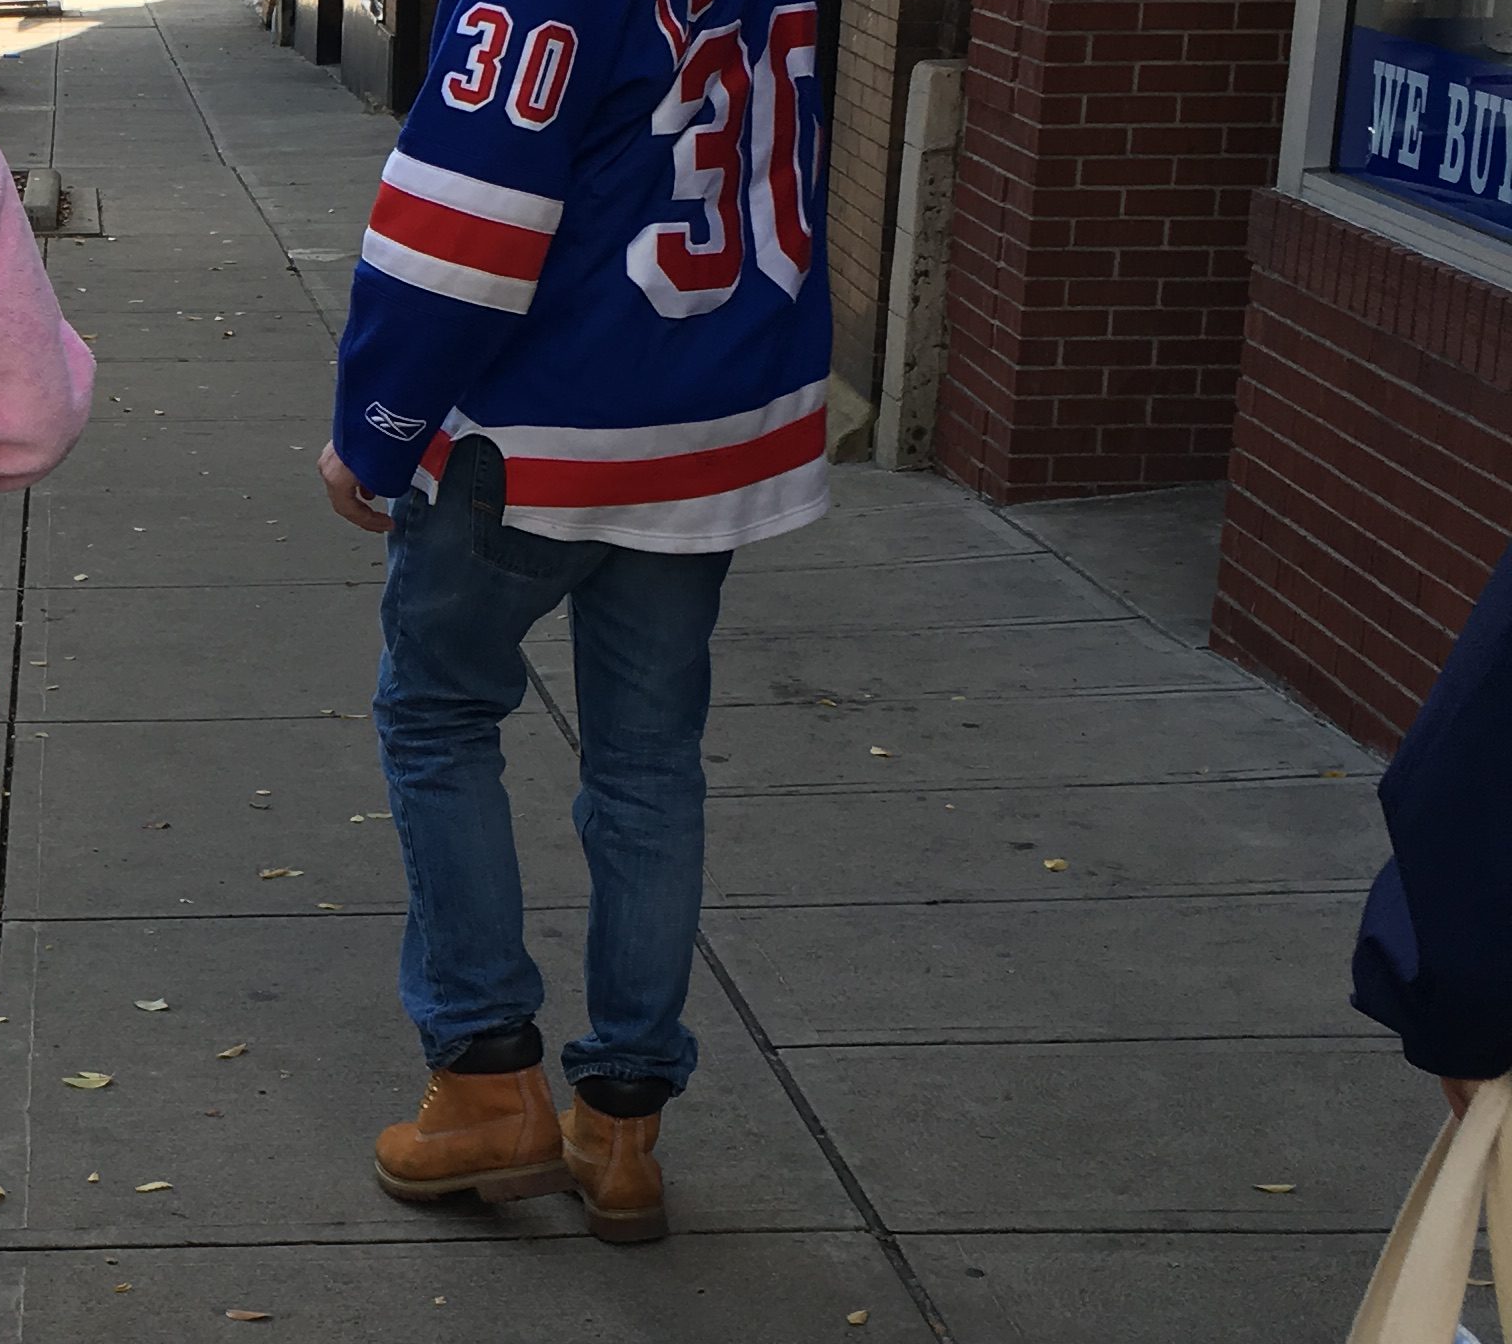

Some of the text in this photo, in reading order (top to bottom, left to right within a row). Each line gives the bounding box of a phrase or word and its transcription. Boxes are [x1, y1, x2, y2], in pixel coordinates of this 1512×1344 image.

[441, 2, 578, 132] 30
[1370, 60, 1429, 170] WE
[626, 1, 819, 320] 30
